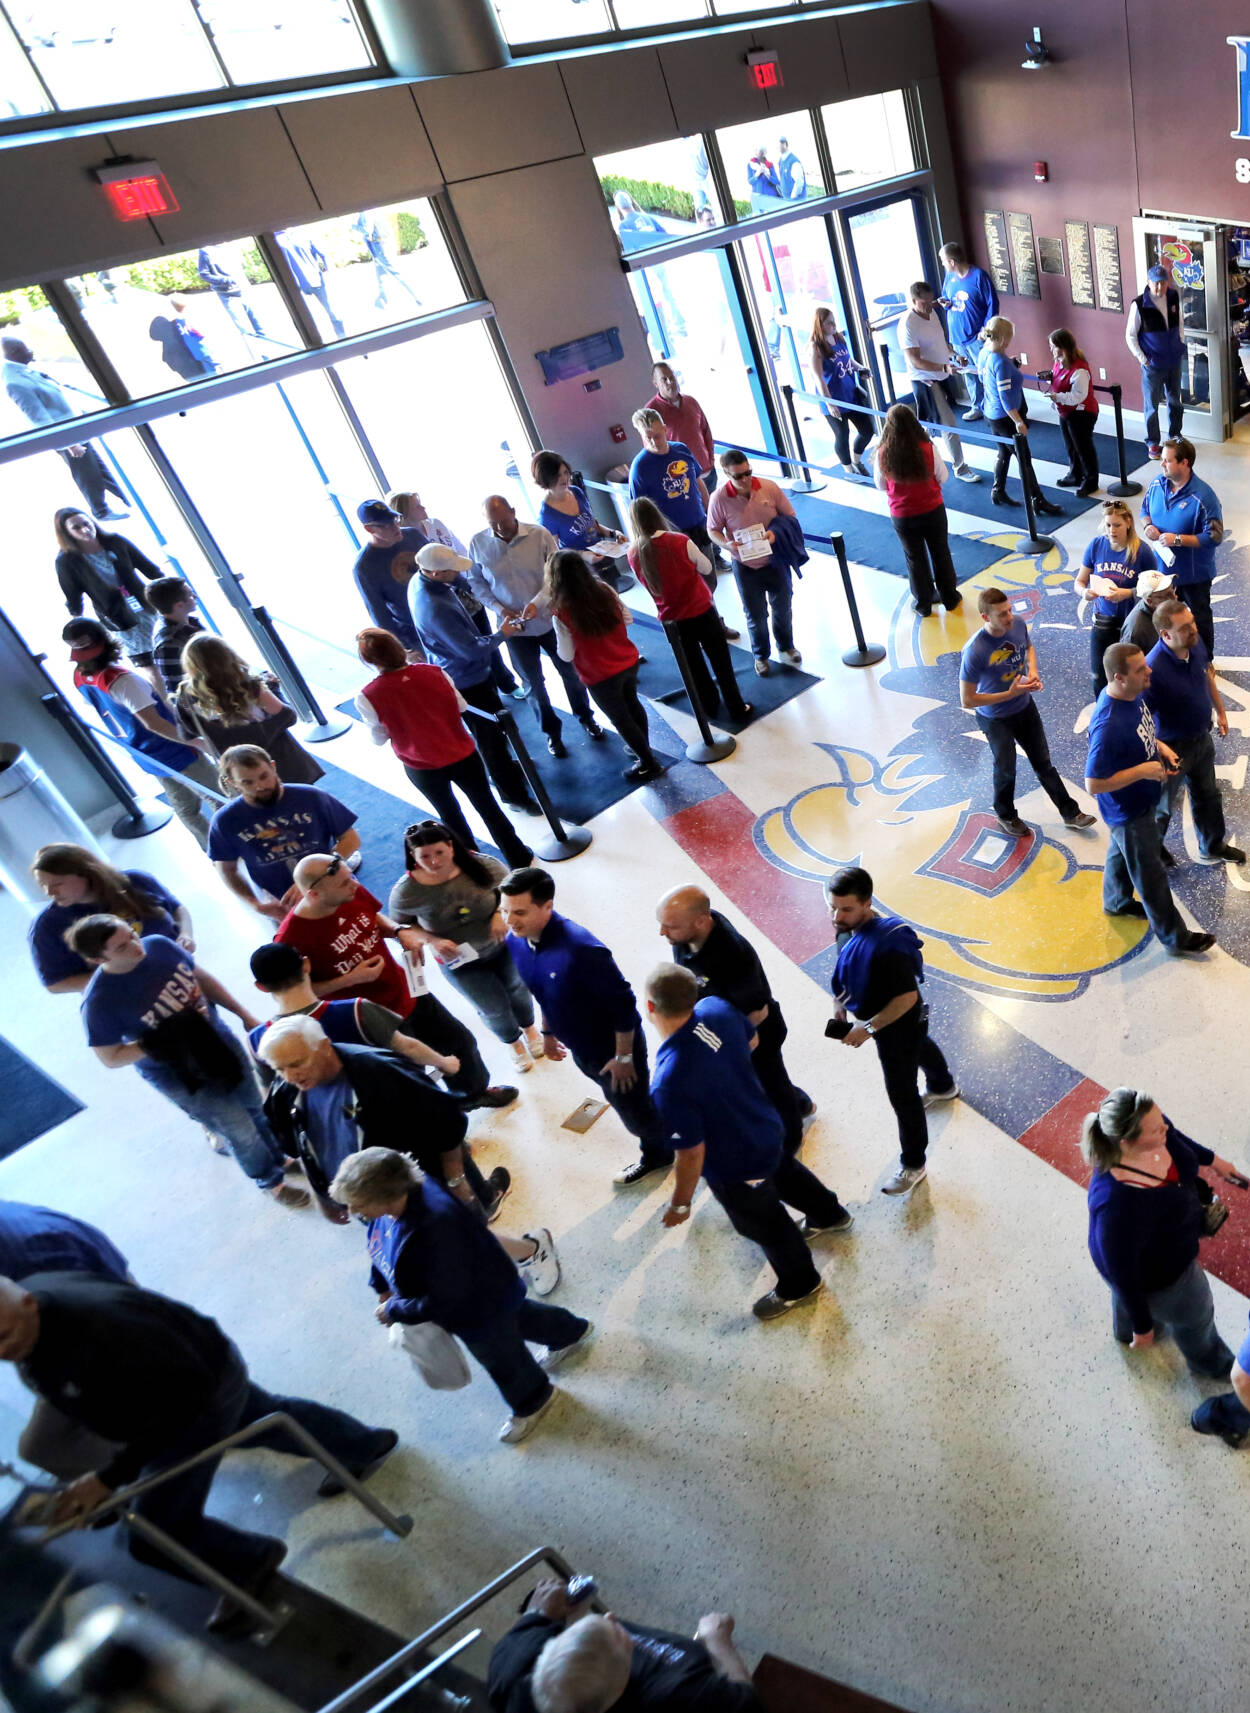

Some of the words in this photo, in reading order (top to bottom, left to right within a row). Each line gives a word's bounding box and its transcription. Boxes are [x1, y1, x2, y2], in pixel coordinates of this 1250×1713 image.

[1096, 561, 1136, 579] KANSAS
[1011, 654, 1021, 664] KU
[331, 923, 364, 954] What
